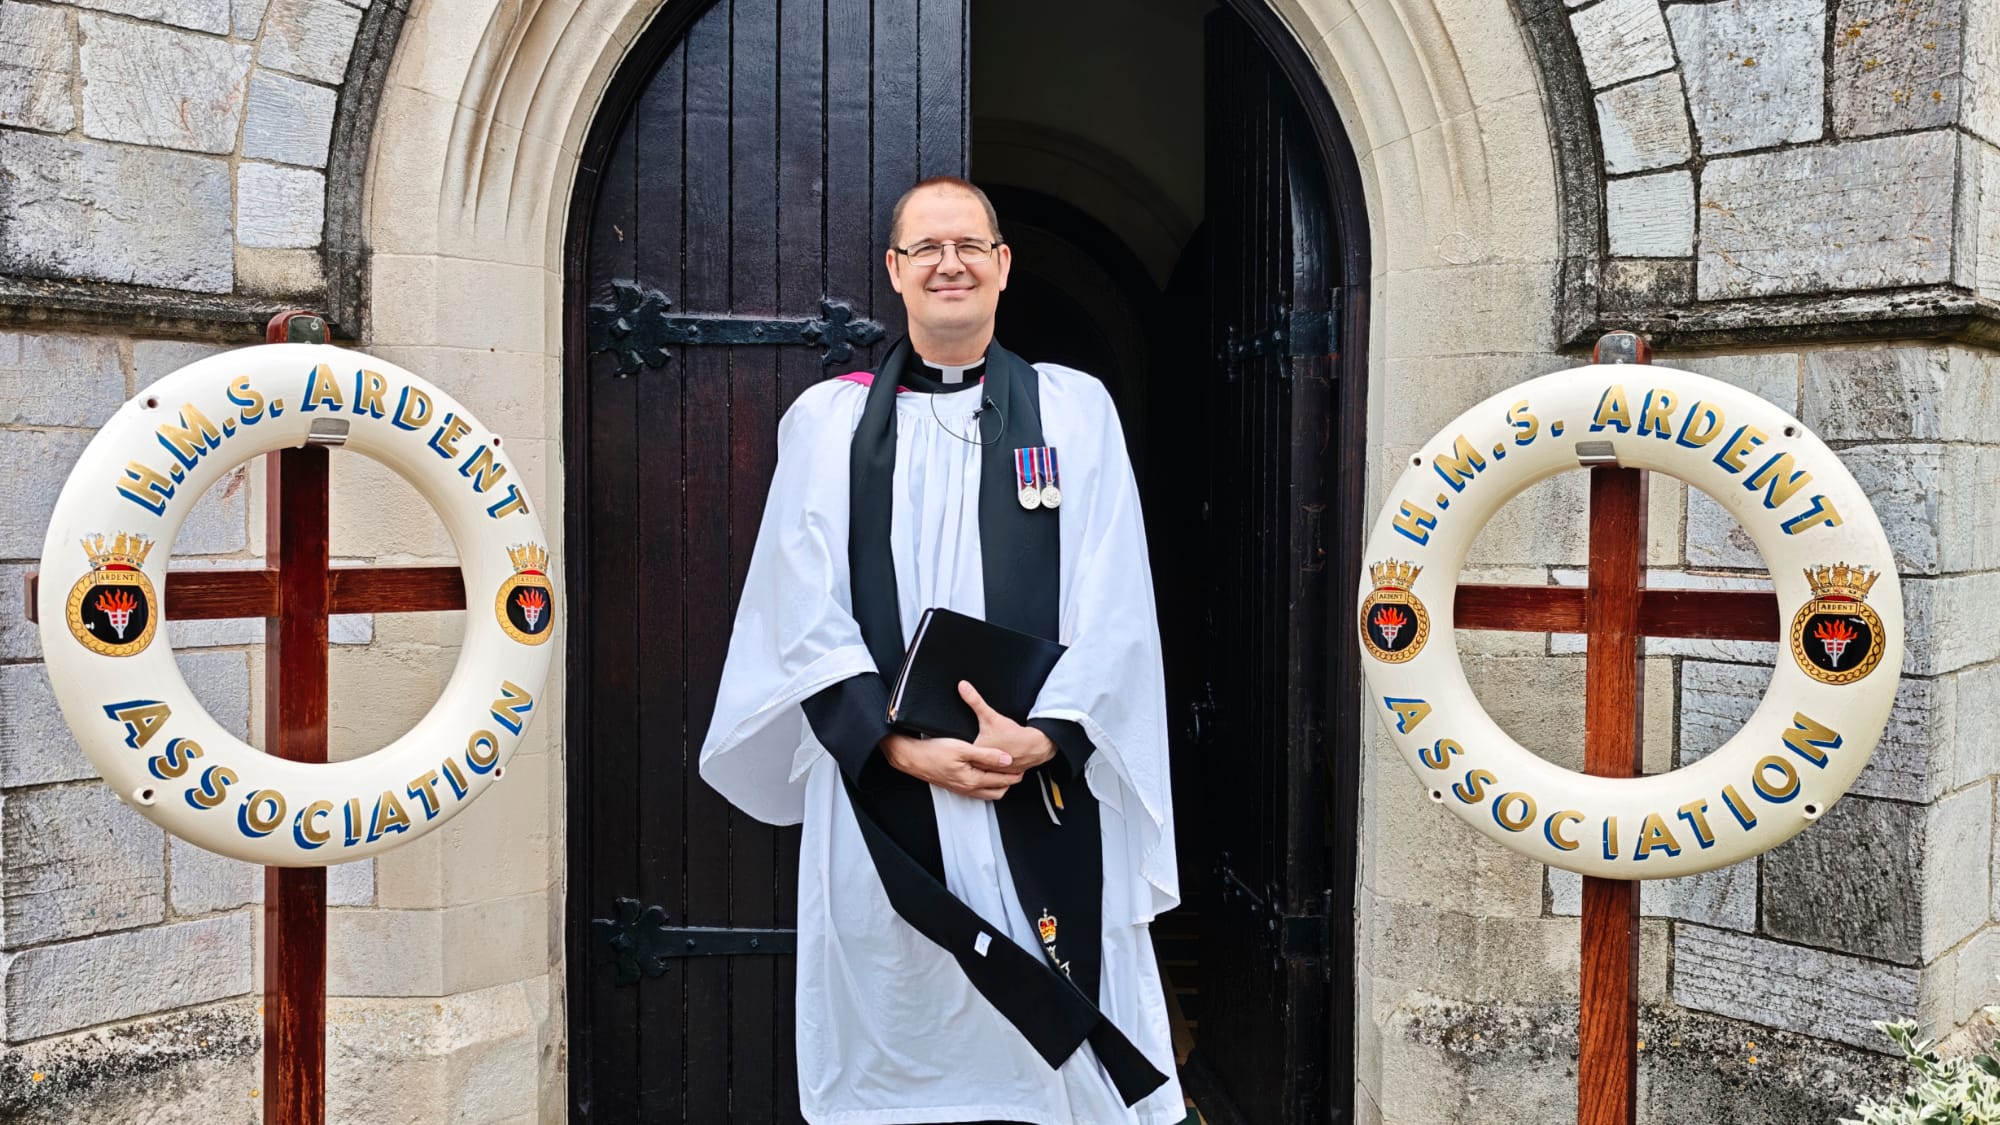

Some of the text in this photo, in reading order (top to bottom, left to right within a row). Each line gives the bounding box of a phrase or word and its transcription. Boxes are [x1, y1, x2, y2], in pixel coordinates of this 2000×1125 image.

[116, 364, 530, 519] H.M.S. ARDENT
[1393, 384, 1843, 546] H.M.S. ARDENT
[103, 680, 533, 849] ASSOCIATION
[1383, 696, 1843, 860] ASSOCIATION
